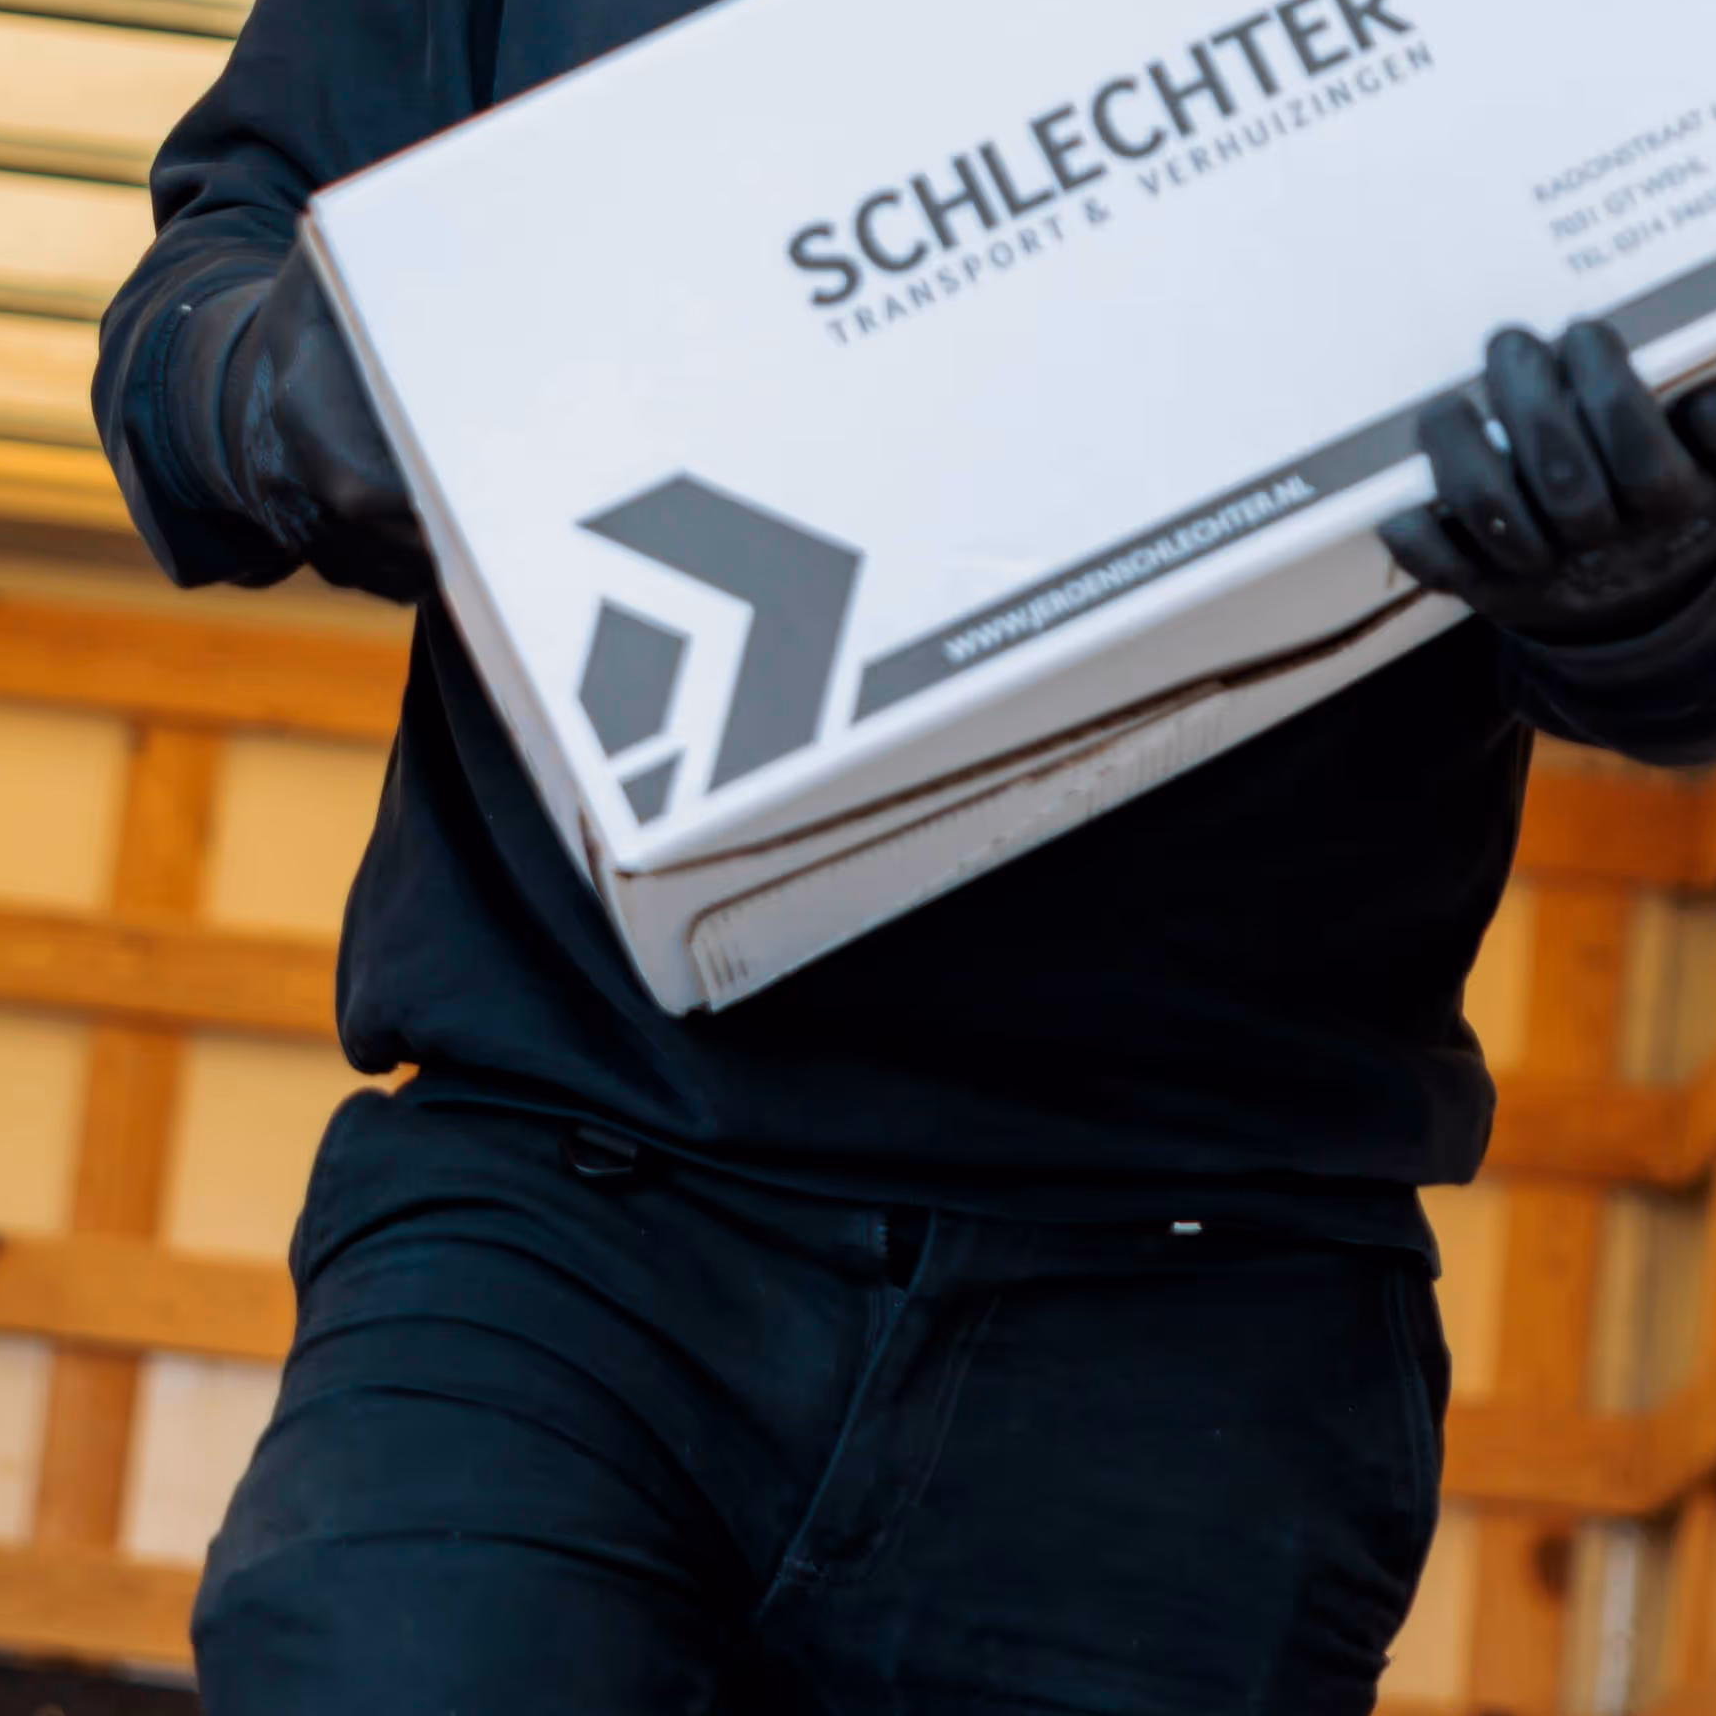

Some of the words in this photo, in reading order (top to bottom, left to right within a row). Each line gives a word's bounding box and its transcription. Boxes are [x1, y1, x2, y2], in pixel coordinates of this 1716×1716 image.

[826, 214, 1068, 348] TRANSPORT
[1084, 197, 1113, 227] &
[1137, 40, 1436, 198] VERHUIZINGEN
[943, 474, 1316, 663] WWW.JEROENSCHLECHTER.NL
